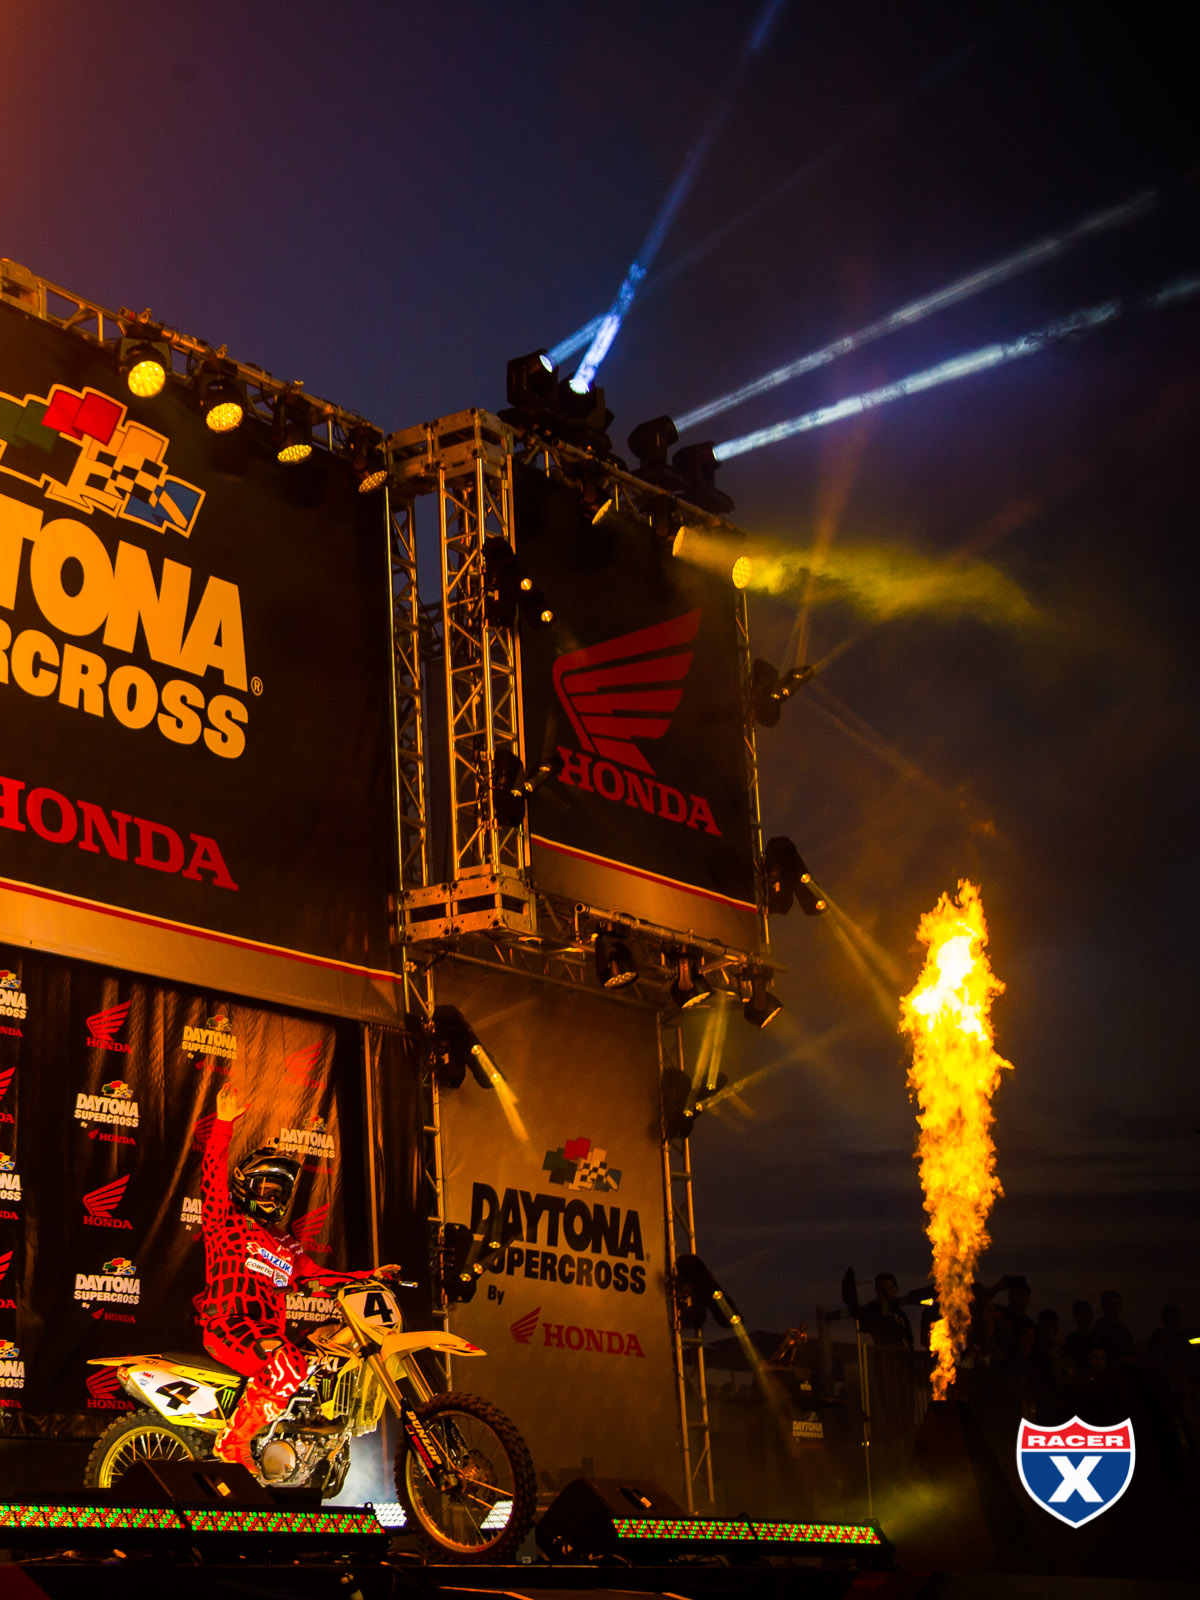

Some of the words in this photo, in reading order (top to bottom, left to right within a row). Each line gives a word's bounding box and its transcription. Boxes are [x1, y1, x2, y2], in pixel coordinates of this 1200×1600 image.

[557, 746, 722, 837] HONDA
[86, 1036, 132, 1054] HONDA
[184, 1026, 237, 1050] DAYTONA
[182, 1041, 238, 1059] SUPERCROSS
[76, 1093, 139, 1118] DAYTONA
[74, 1109, 139, 1128] SUPERCROSS
[280, 1128, 335, 1149] DAYTONA
[279, 1142, 335, 1159] SUPERCROSS
[83, 1216, 133, 1229] HONDA
[470, 1182, 644, 1261] DAYTONA
[302, 1241, 333, 1254] NDA
[486, 1246, 646, 1295] UPERCROSS
[75, 1274, 141, 1294] DAYTONA
[74, 1290, 140, 1304] SUPERCROSS
[488, 1285, 504, 1305] By
[364, 1292, 393, 1323] 4
[542, 1323, 645, 1357] HONDA
[304, 1354, 339, 1372] ZUKI
[87, 1399, 135, 1410] HONDA
[155, 1381, 199, 1410] 4
[406, 1411, 441, 1464] DUNLOP
